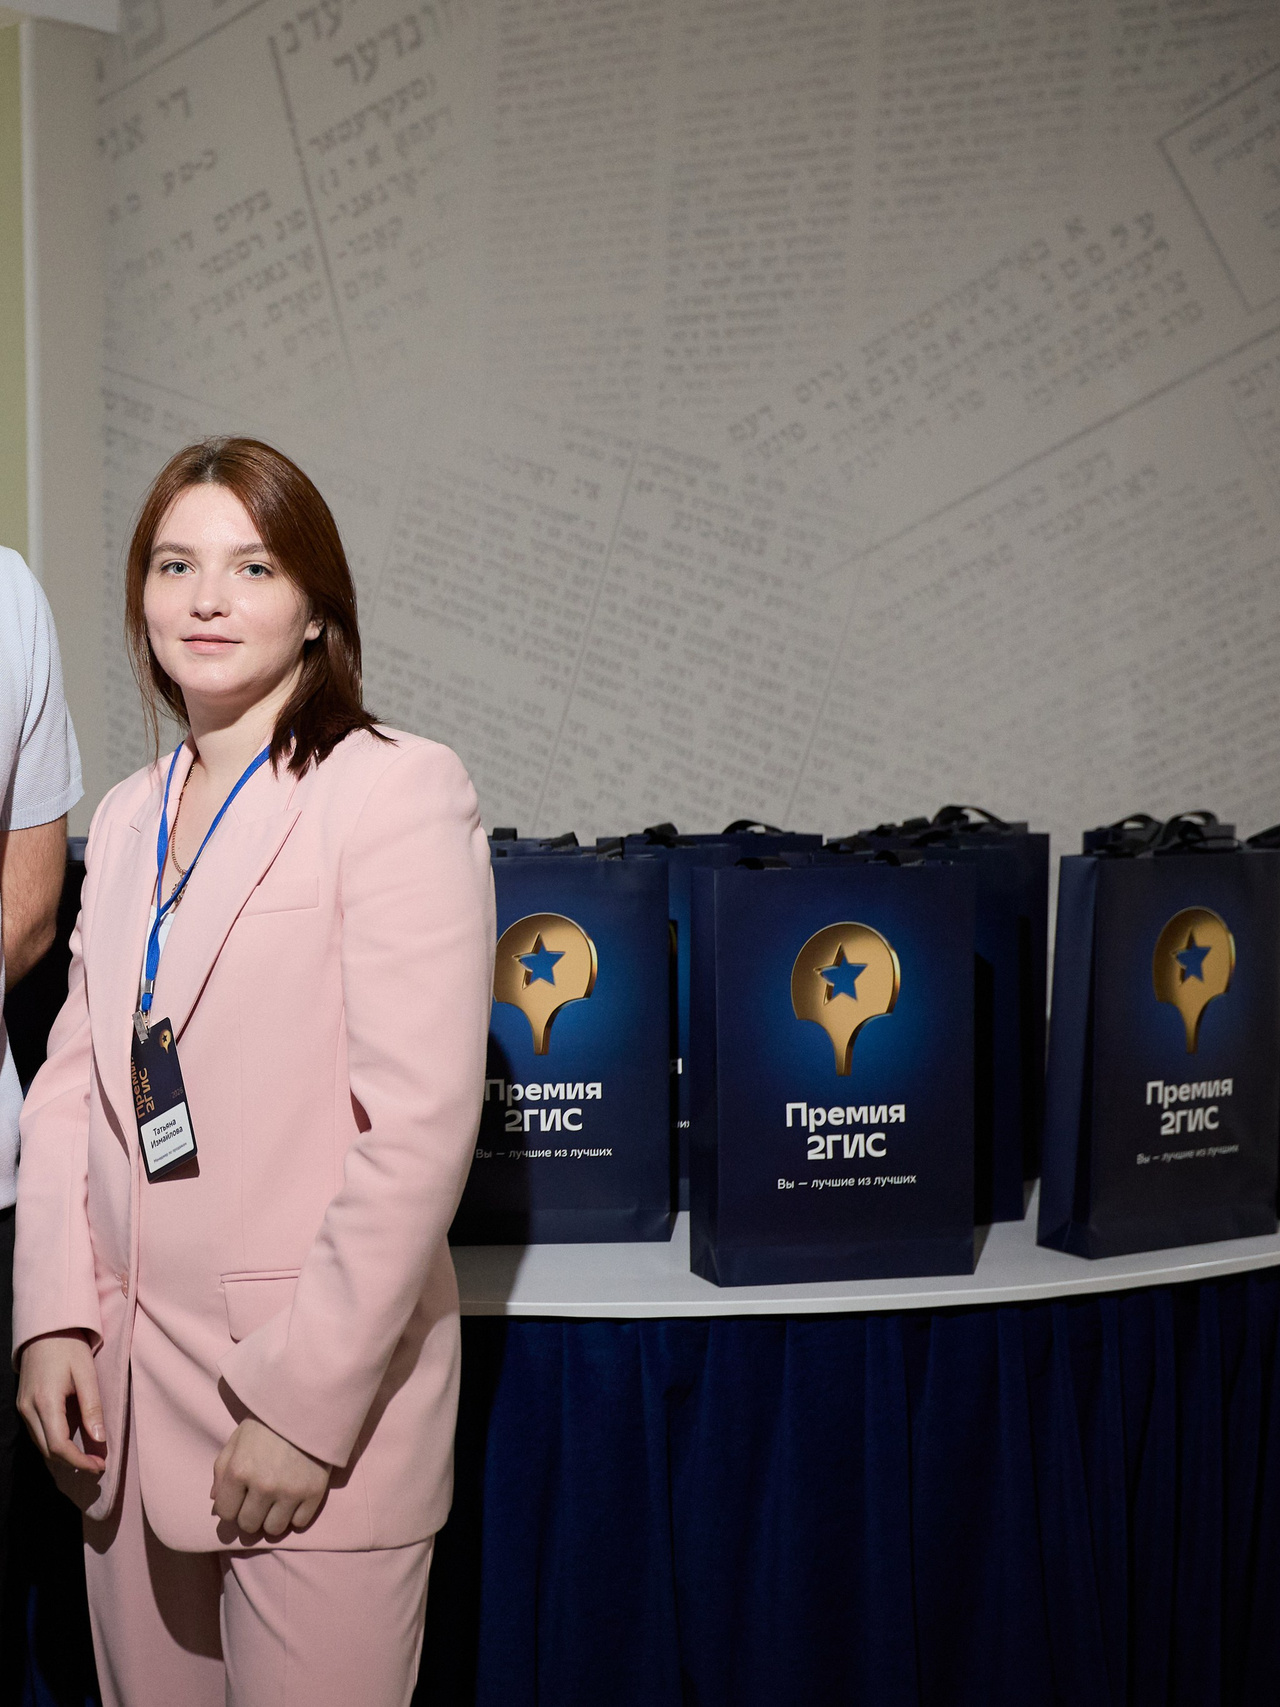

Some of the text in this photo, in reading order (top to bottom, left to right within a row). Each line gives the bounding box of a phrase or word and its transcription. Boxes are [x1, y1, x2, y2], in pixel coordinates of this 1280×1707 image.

[130, 1057, 146, 1119] Преми
[139, 1067, 156, 1113] 2ГИС
[485, 1079, 603, 1107] Премия
[1146, 1078, 1234, 1109] Премия
[153, 1119, 177, 1137] Татьяна
[505, 1107, 583, 1132] 2ГИС
[785, 1101, 907, 1133] Премия
[1160, 1105, 1220, 1136] 2ГИС
[150, 1126, 183, 1149] Измайлова
[807, 1132, 888, 1161] 2ГИС
[475, 1148, 492, 1159] Вы
[508, 1149, 552, 1160] лучшие
[554, 1148, 568, 1158] из
[569, 1147, 613, 1160] лучших
[777, 1178, 795, 1190] Вы
[811, 1177, 855, 1191] лучшие
[857, 1176, 872, 1187] из
[873, 1174, 917, 1188] лучших
